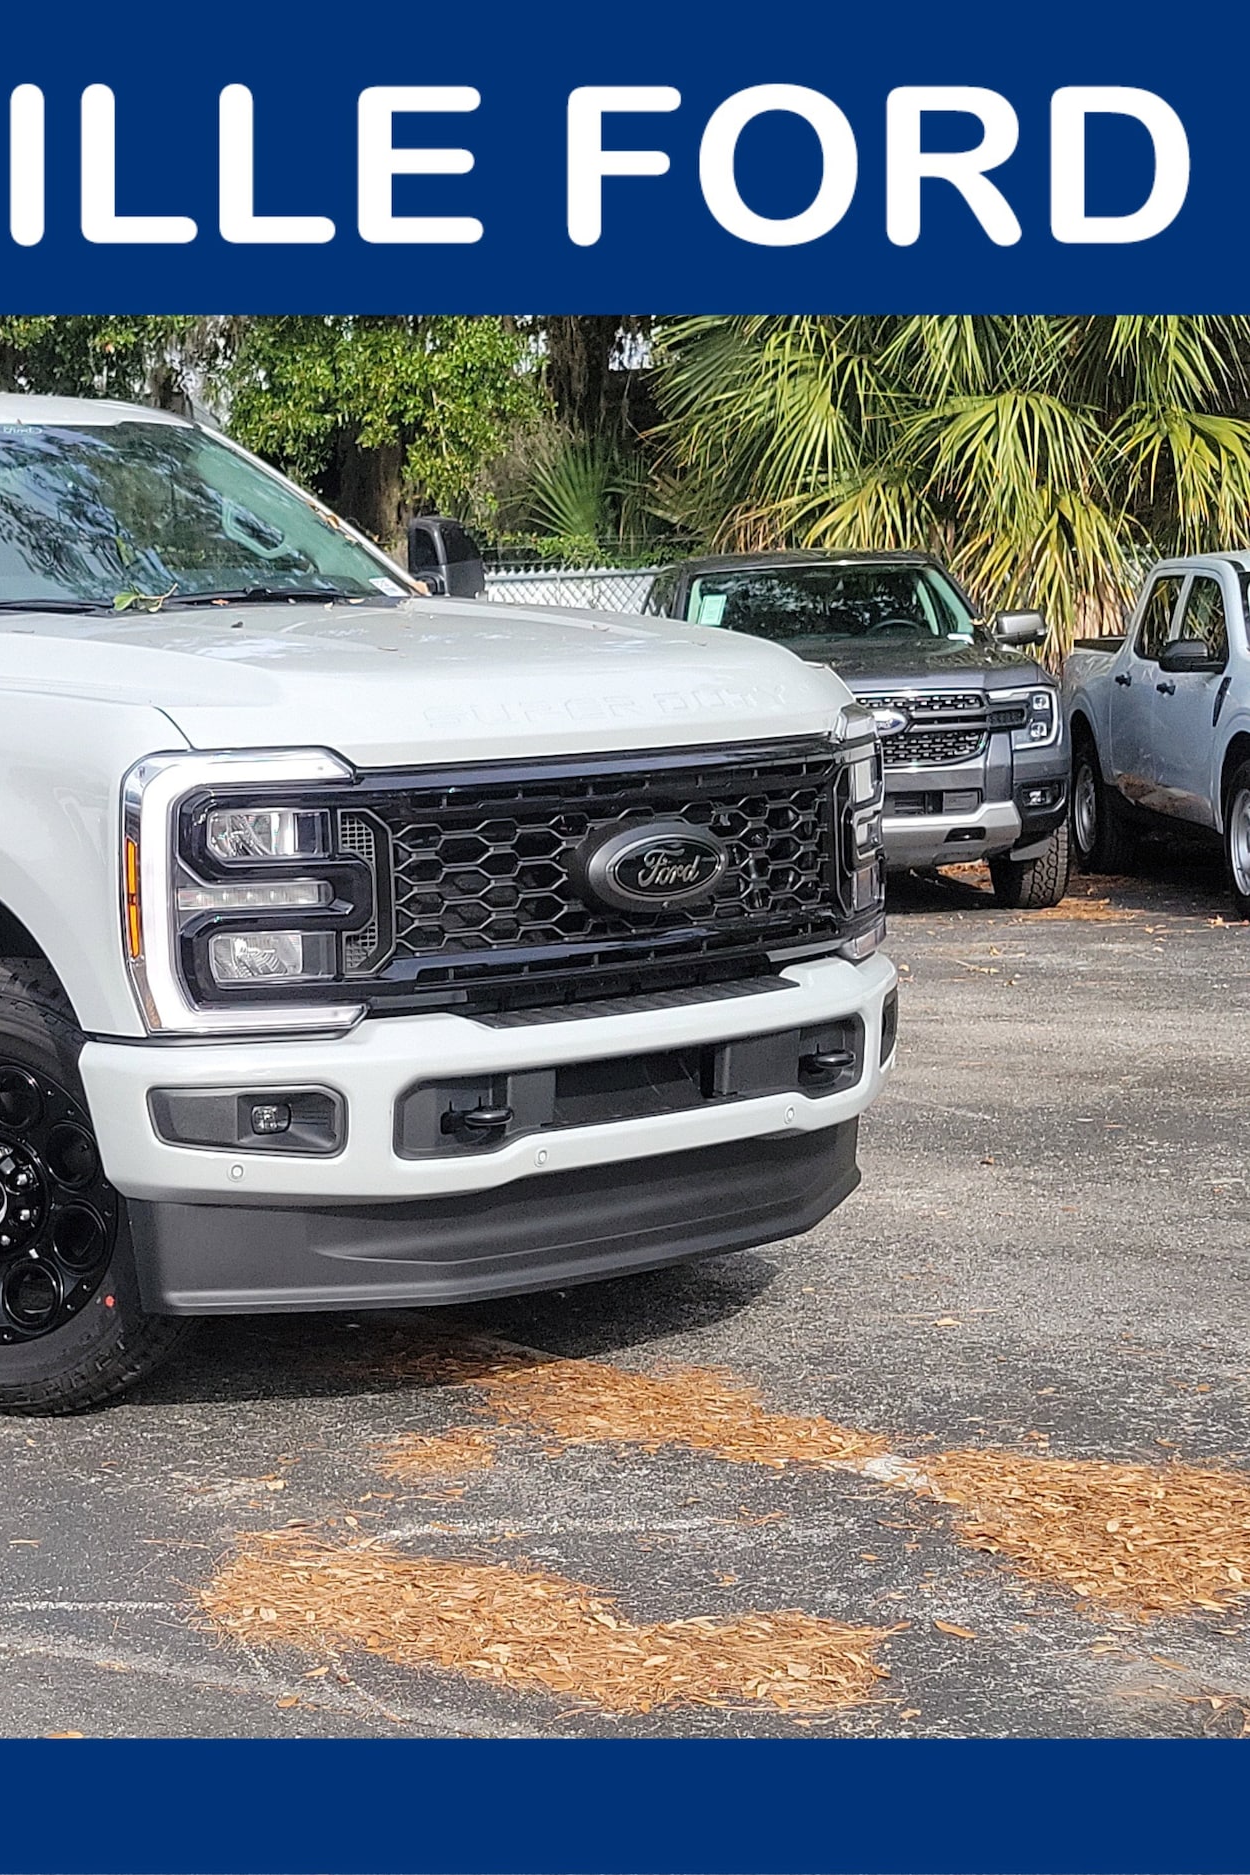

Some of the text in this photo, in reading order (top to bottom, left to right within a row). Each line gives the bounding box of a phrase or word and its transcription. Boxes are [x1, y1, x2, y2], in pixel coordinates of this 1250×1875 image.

[423, 684, 787, 729] SUPER DUTY
[637, 848, 700, 888] Ford
